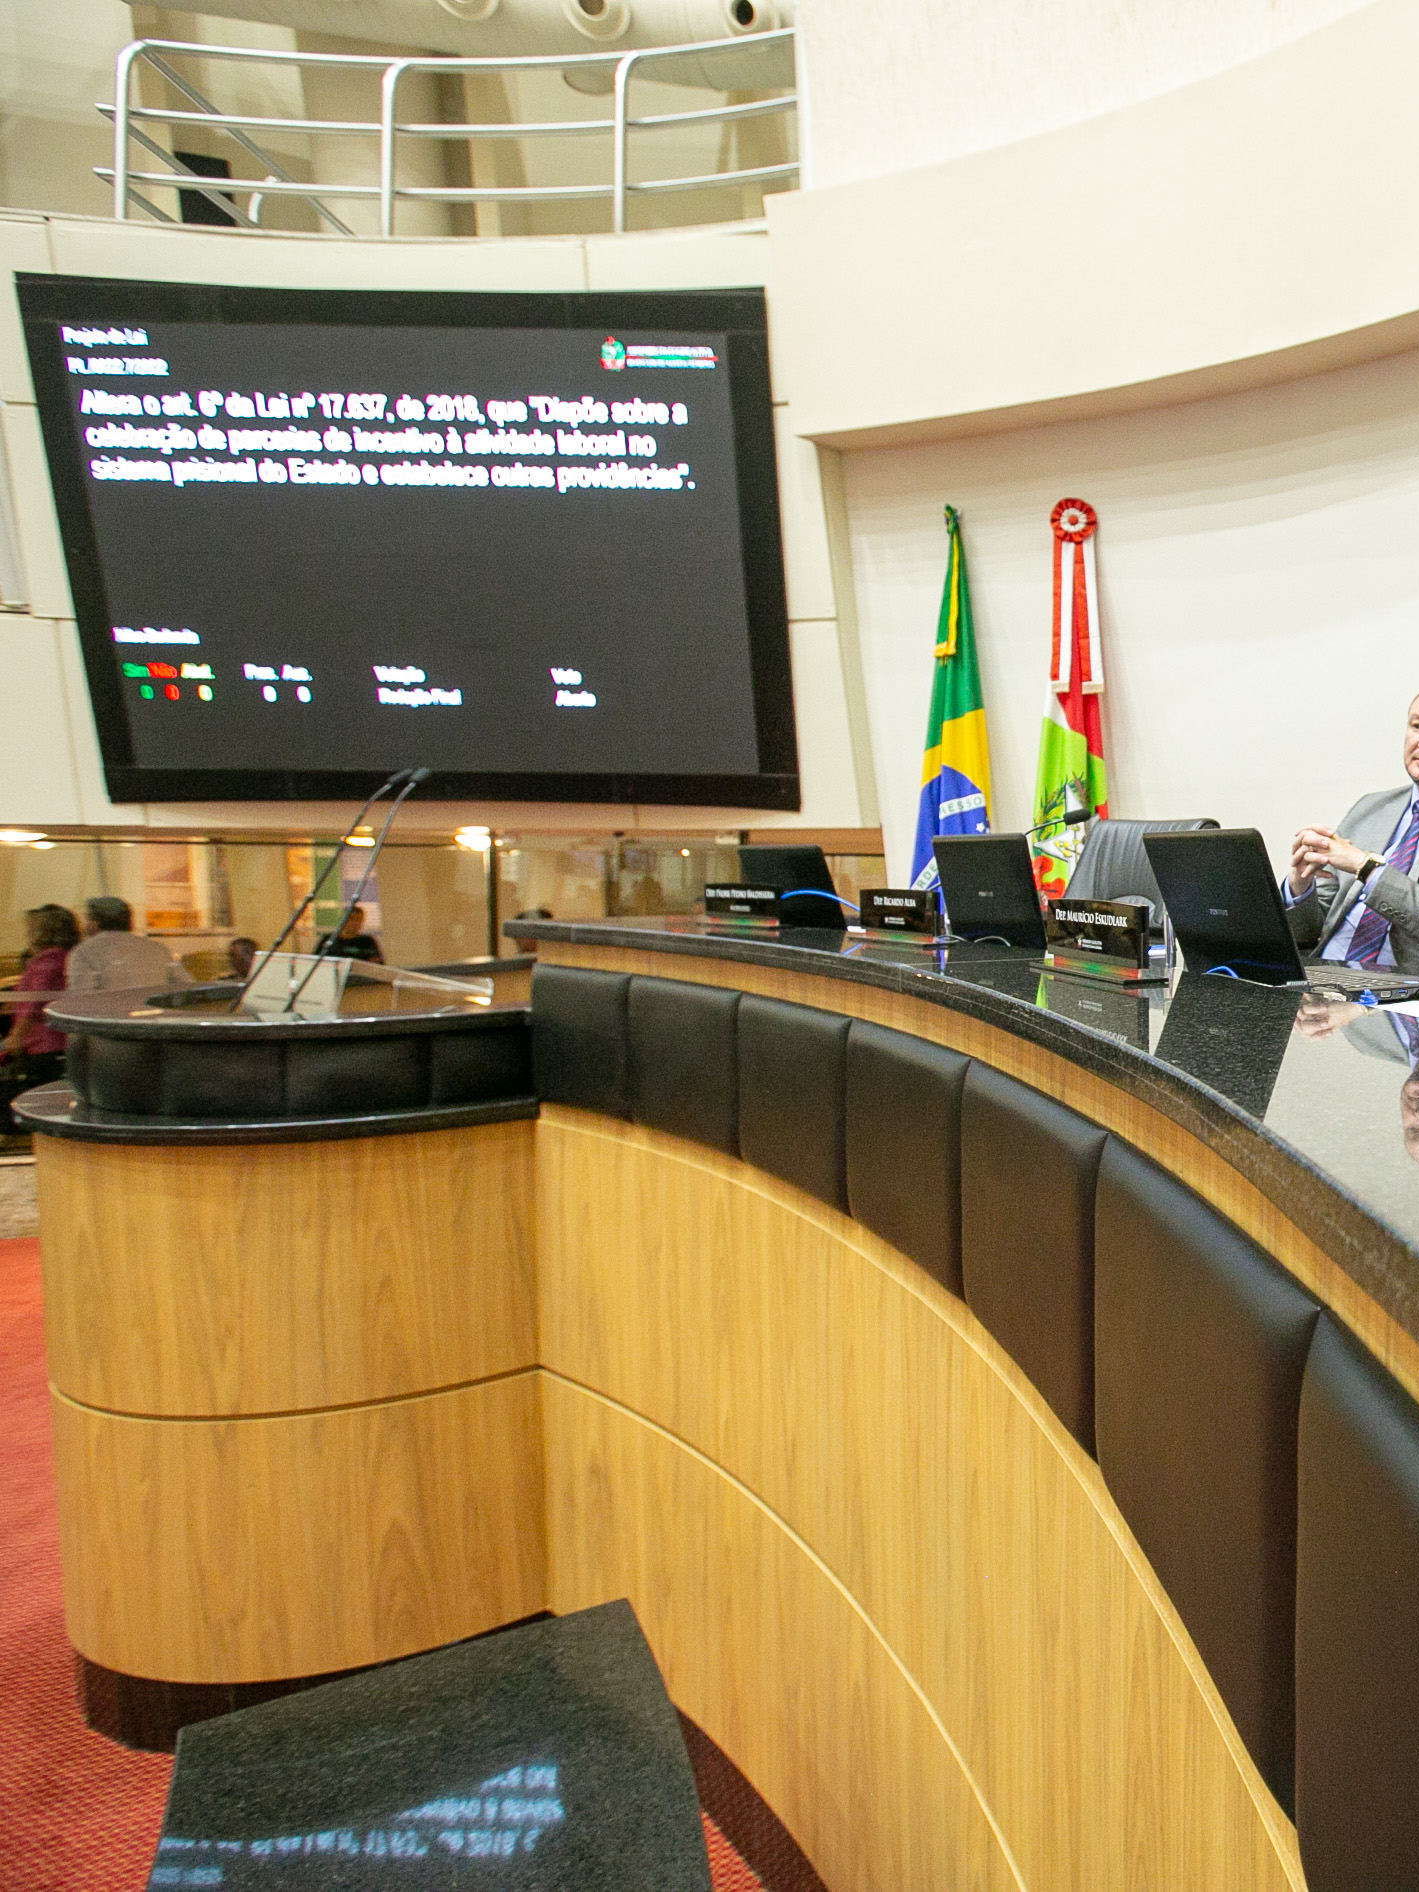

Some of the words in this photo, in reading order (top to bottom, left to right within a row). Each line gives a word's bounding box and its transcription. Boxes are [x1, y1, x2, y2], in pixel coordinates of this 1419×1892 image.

[143, 395, 161, 416] o
[225, 392, 255, 418] da
[255, 392, 290, 418] Lei
[395, 394, 425, 421] de
[486, 399, 528, 427] que
[609, 397, 669, 425] sobre
[671, 402, 688, 425] a
[197, 424, 227, 450] de
[323, 426, 352, 453] de
[352, 426, 445, 454] incentivo
[463, 428, 556, 456] atividade
[555, 429, 626, 457] laboral
[627, 434, 657, 458] no
[258, 458, 288, 484] do
[287, 457, 361, 485] Estado
[361, 463, 379, 486] e
[490, 461, 556, 488] outras
